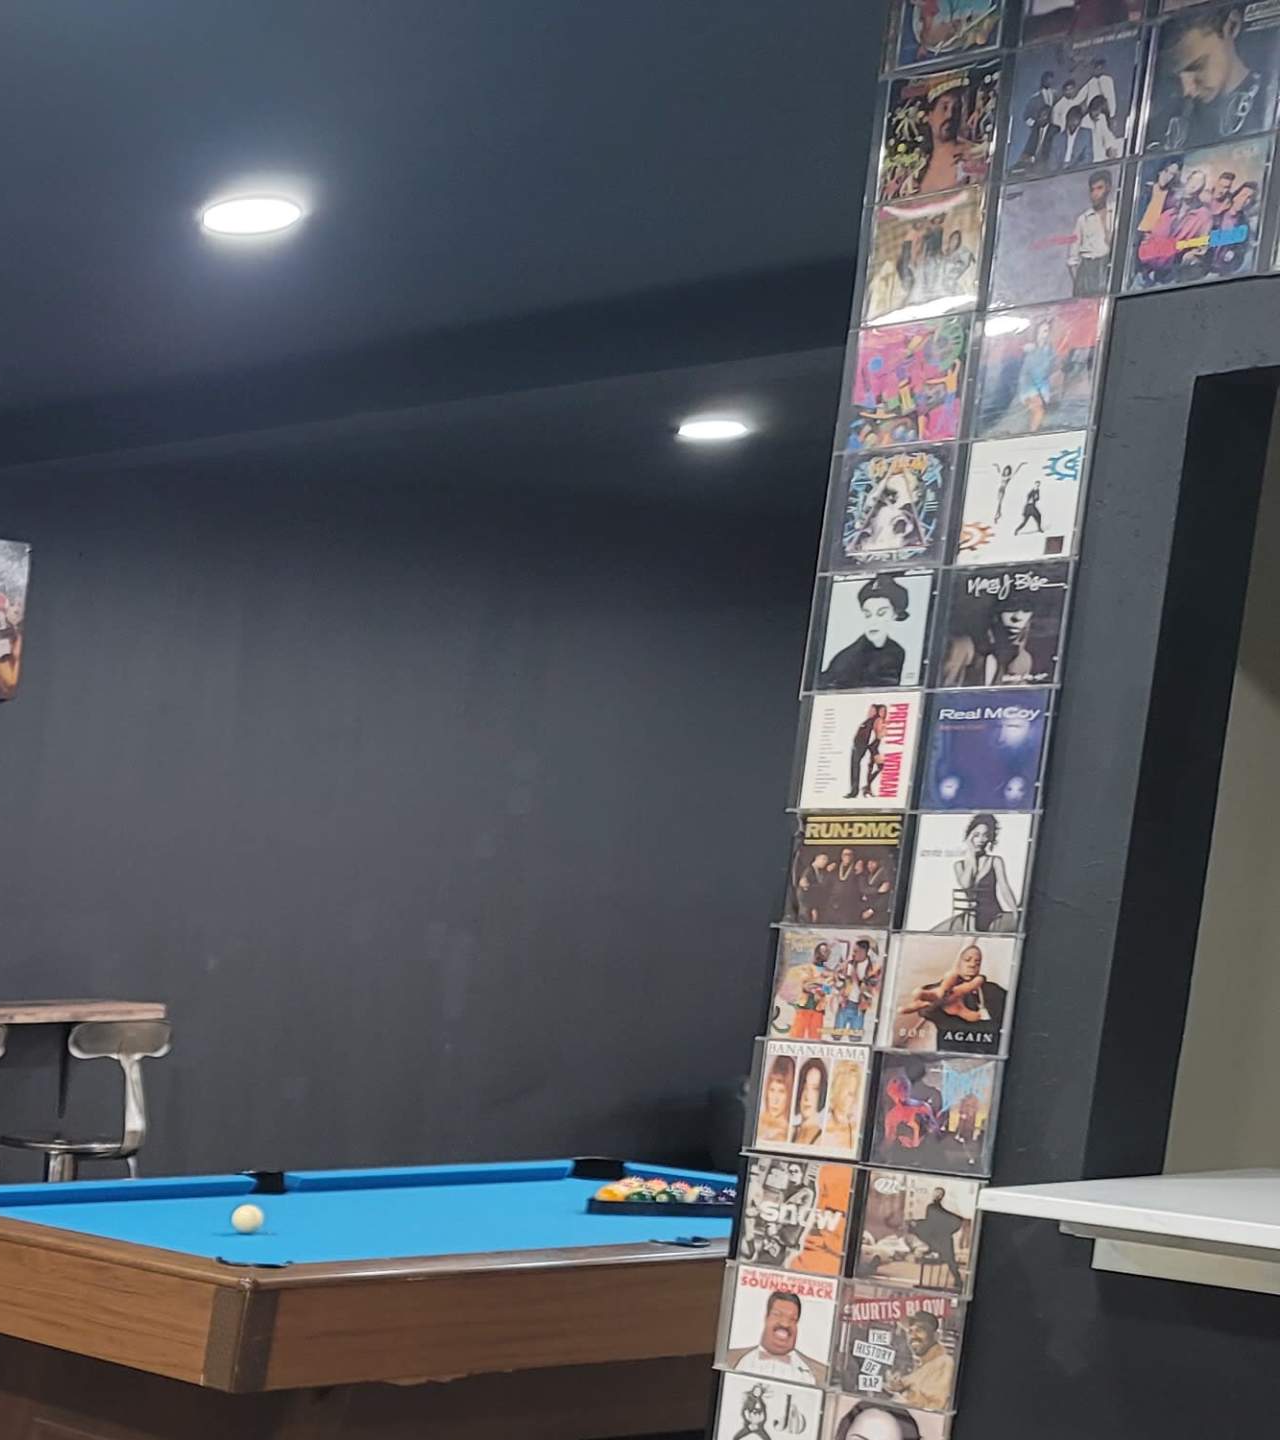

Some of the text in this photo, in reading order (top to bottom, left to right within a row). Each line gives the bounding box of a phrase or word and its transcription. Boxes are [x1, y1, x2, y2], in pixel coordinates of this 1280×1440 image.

[938, 707, 982, 721] Real
[879, 703, 911, 798] PRETTY WOMAN
[804, 821, 903, 838] RUN-DMC
[943, 1031, 994, 1043] AGAIN
[768, 1042, 866, 1059] BANANARAMA
[759, 1201, 843, 1232] snow
[740, 1275, 834, 1300] SOUNDTRACK
[852, 1301, 902, 1321] KURTIS
[871, 1331, 889, 1343] THE
[855, 1342, 893, 1361] HISTORY
